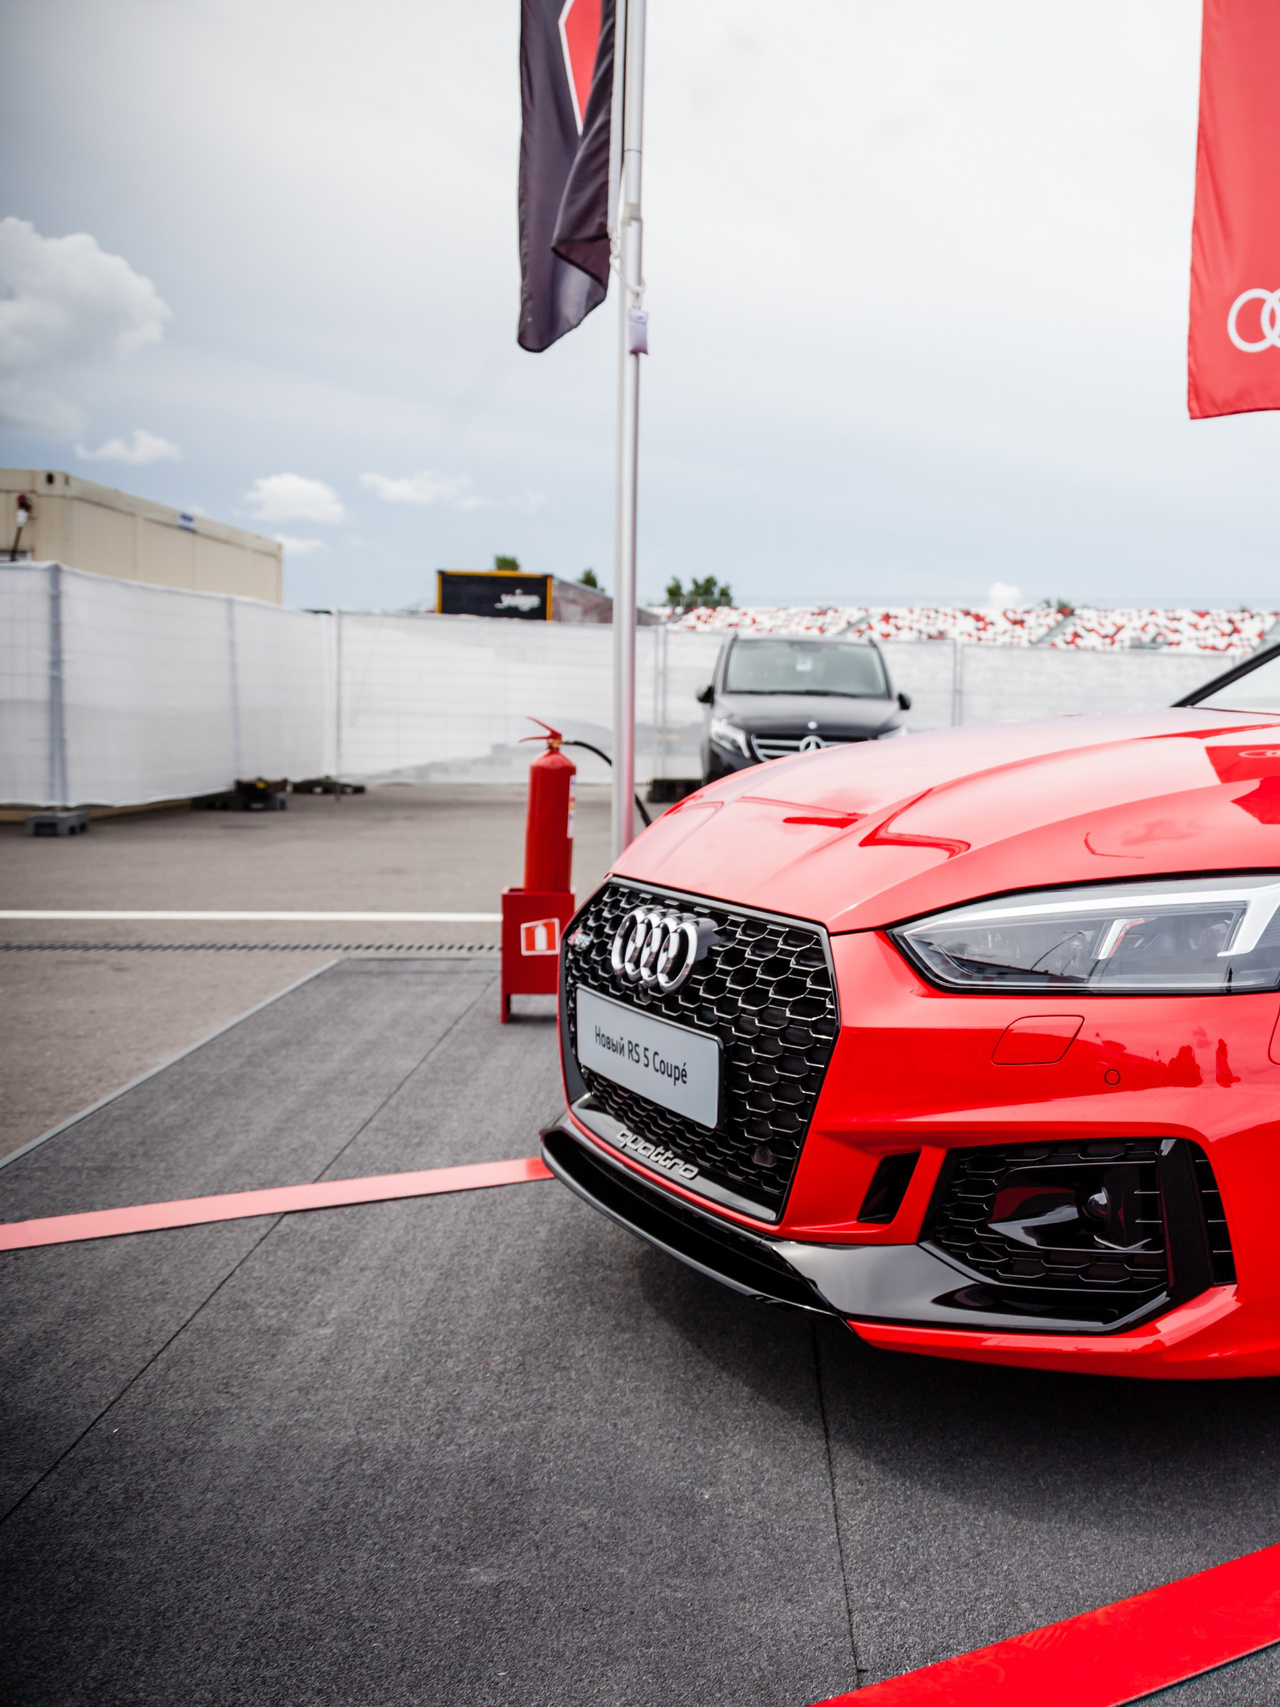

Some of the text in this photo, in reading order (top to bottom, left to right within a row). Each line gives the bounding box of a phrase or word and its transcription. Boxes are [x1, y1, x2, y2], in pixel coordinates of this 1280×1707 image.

[595, 1025, 688, 1086] Новый RS 5 Coupé
[616, 1129, 699, 1180] quattro
